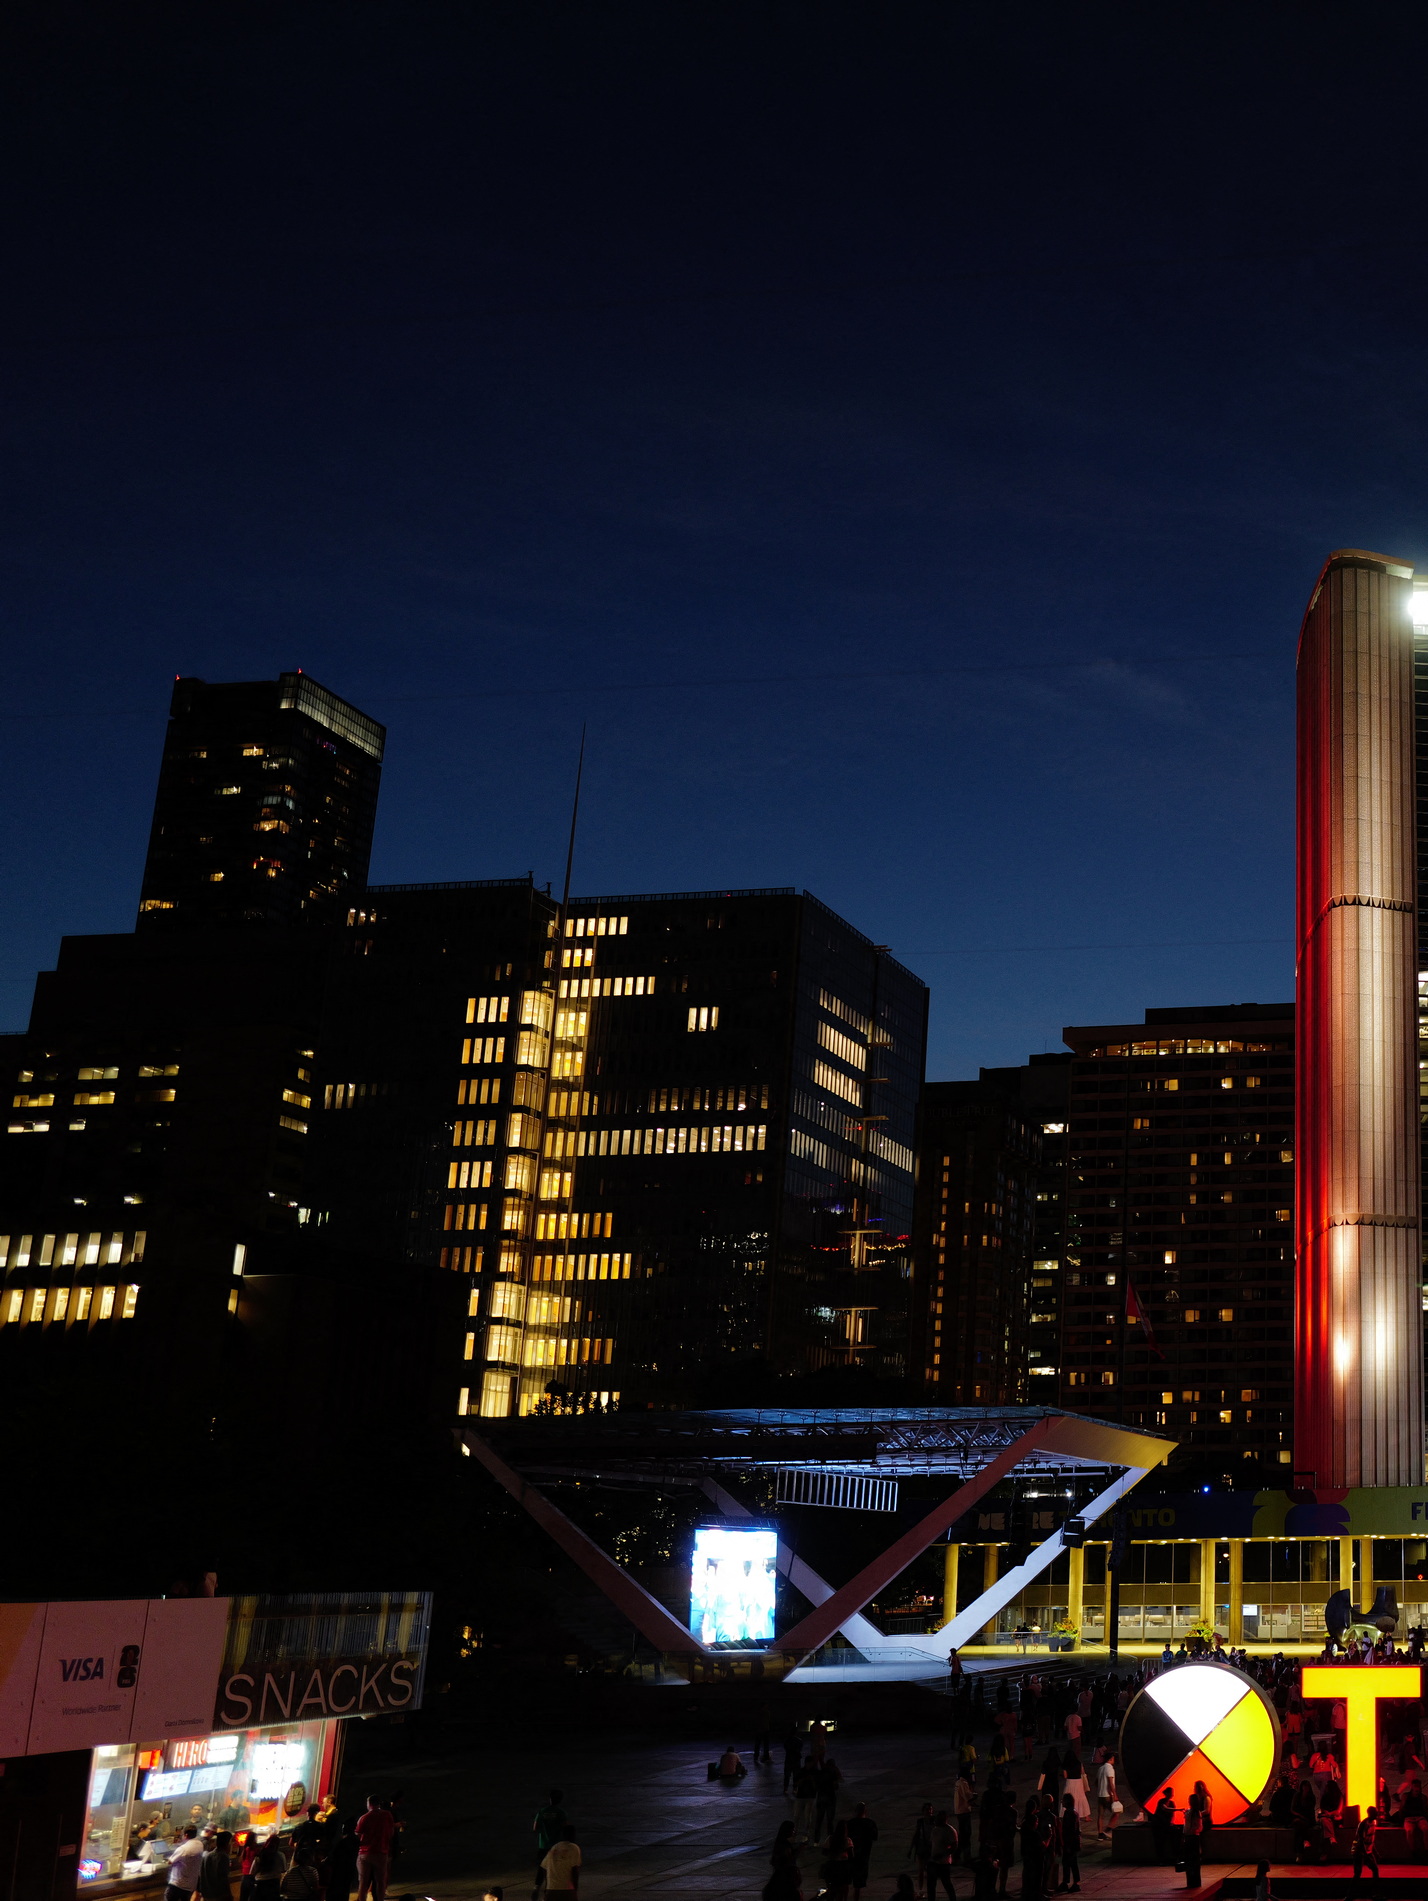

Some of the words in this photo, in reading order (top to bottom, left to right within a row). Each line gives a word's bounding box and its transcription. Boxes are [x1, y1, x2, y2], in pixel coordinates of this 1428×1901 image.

[59, 1657, 104, 1682] VISA
[220, 1660, 414, 1725] SNACKS
[97, 1704, 121, 1713] Partner
